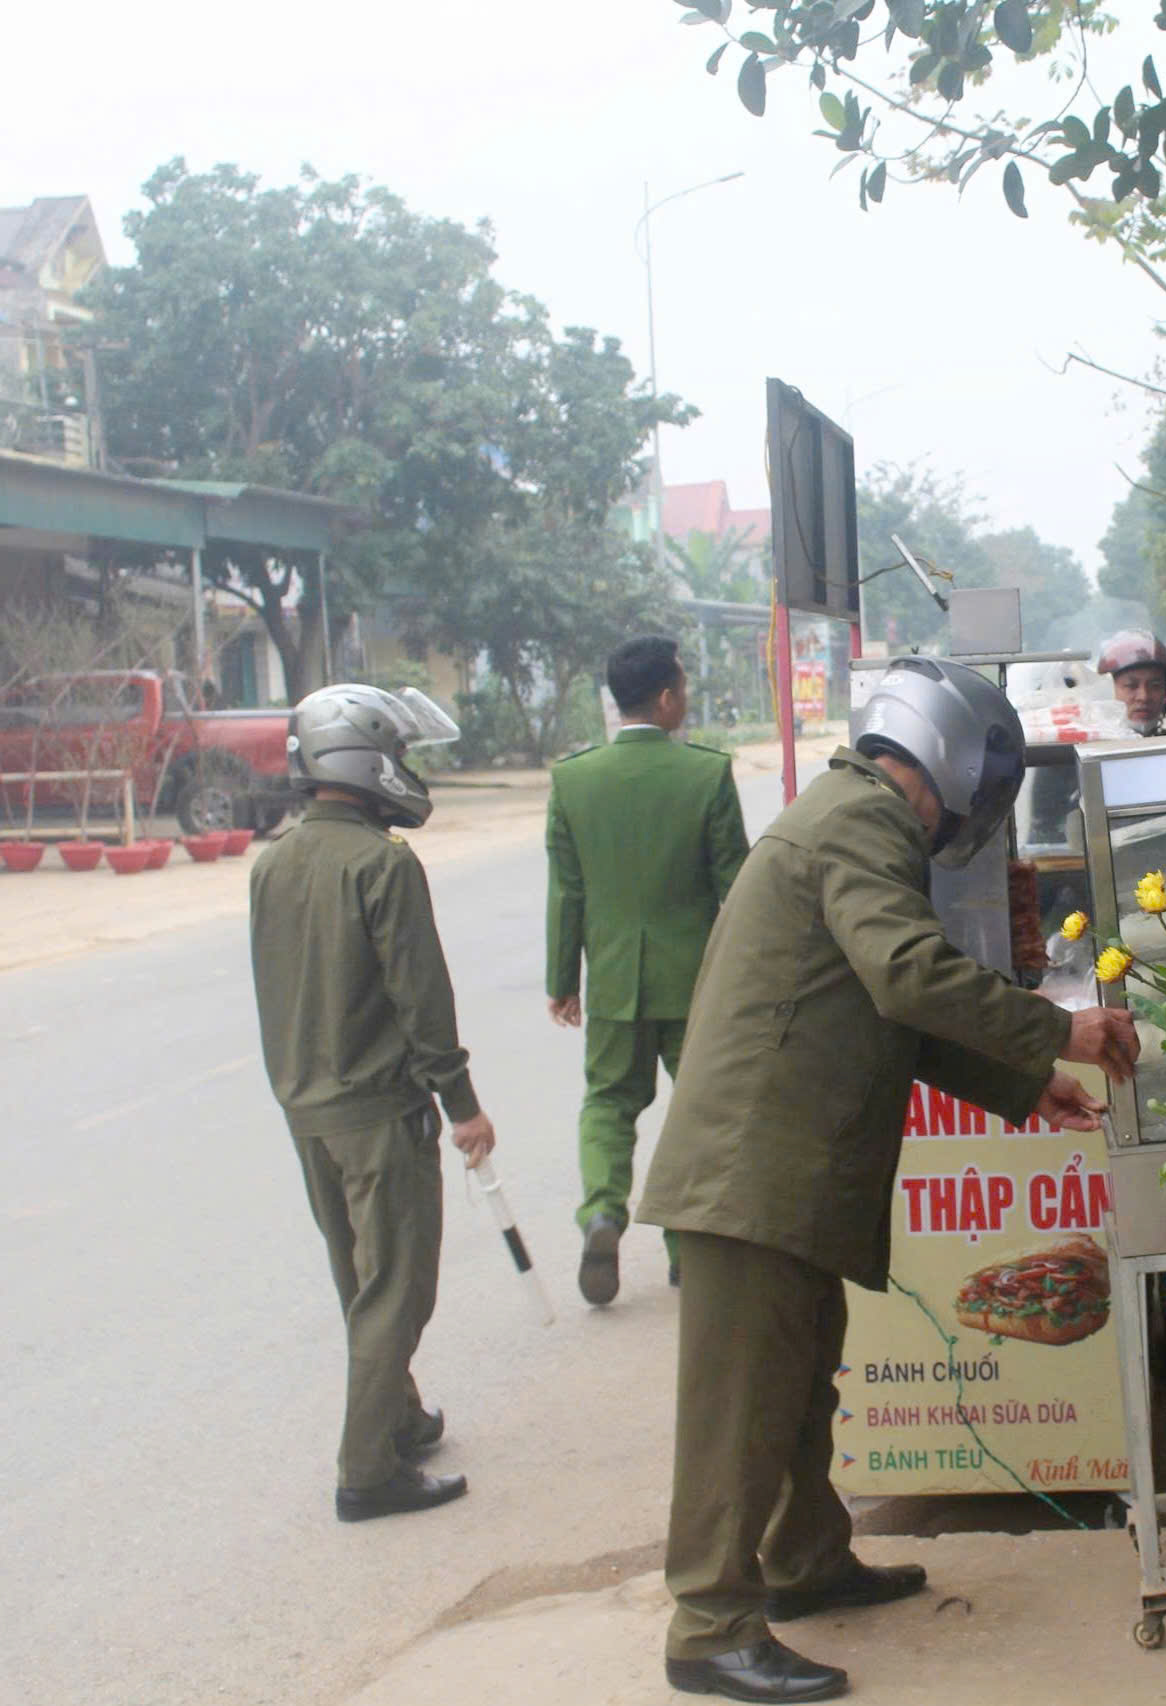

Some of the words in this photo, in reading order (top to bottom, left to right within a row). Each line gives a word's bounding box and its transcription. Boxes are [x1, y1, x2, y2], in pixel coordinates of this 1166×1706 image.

[902, 1167, 1014, 1242] THẬP
[1029, 1153, 1112, 1230] CẨN
[865, 1358, 925, 1383] BÁNH
[933, 1352, 999, 1382] CHUỐI
[867, 1402, 921, 1427] BÁNH
[927, 1405, 987, 1426] KHOAI
[993, 1400, 1032, 1425] SỮA
[869, 1445, 929, 1471] BÁNH
[936, 1443, 984, 1470] TIÊU
